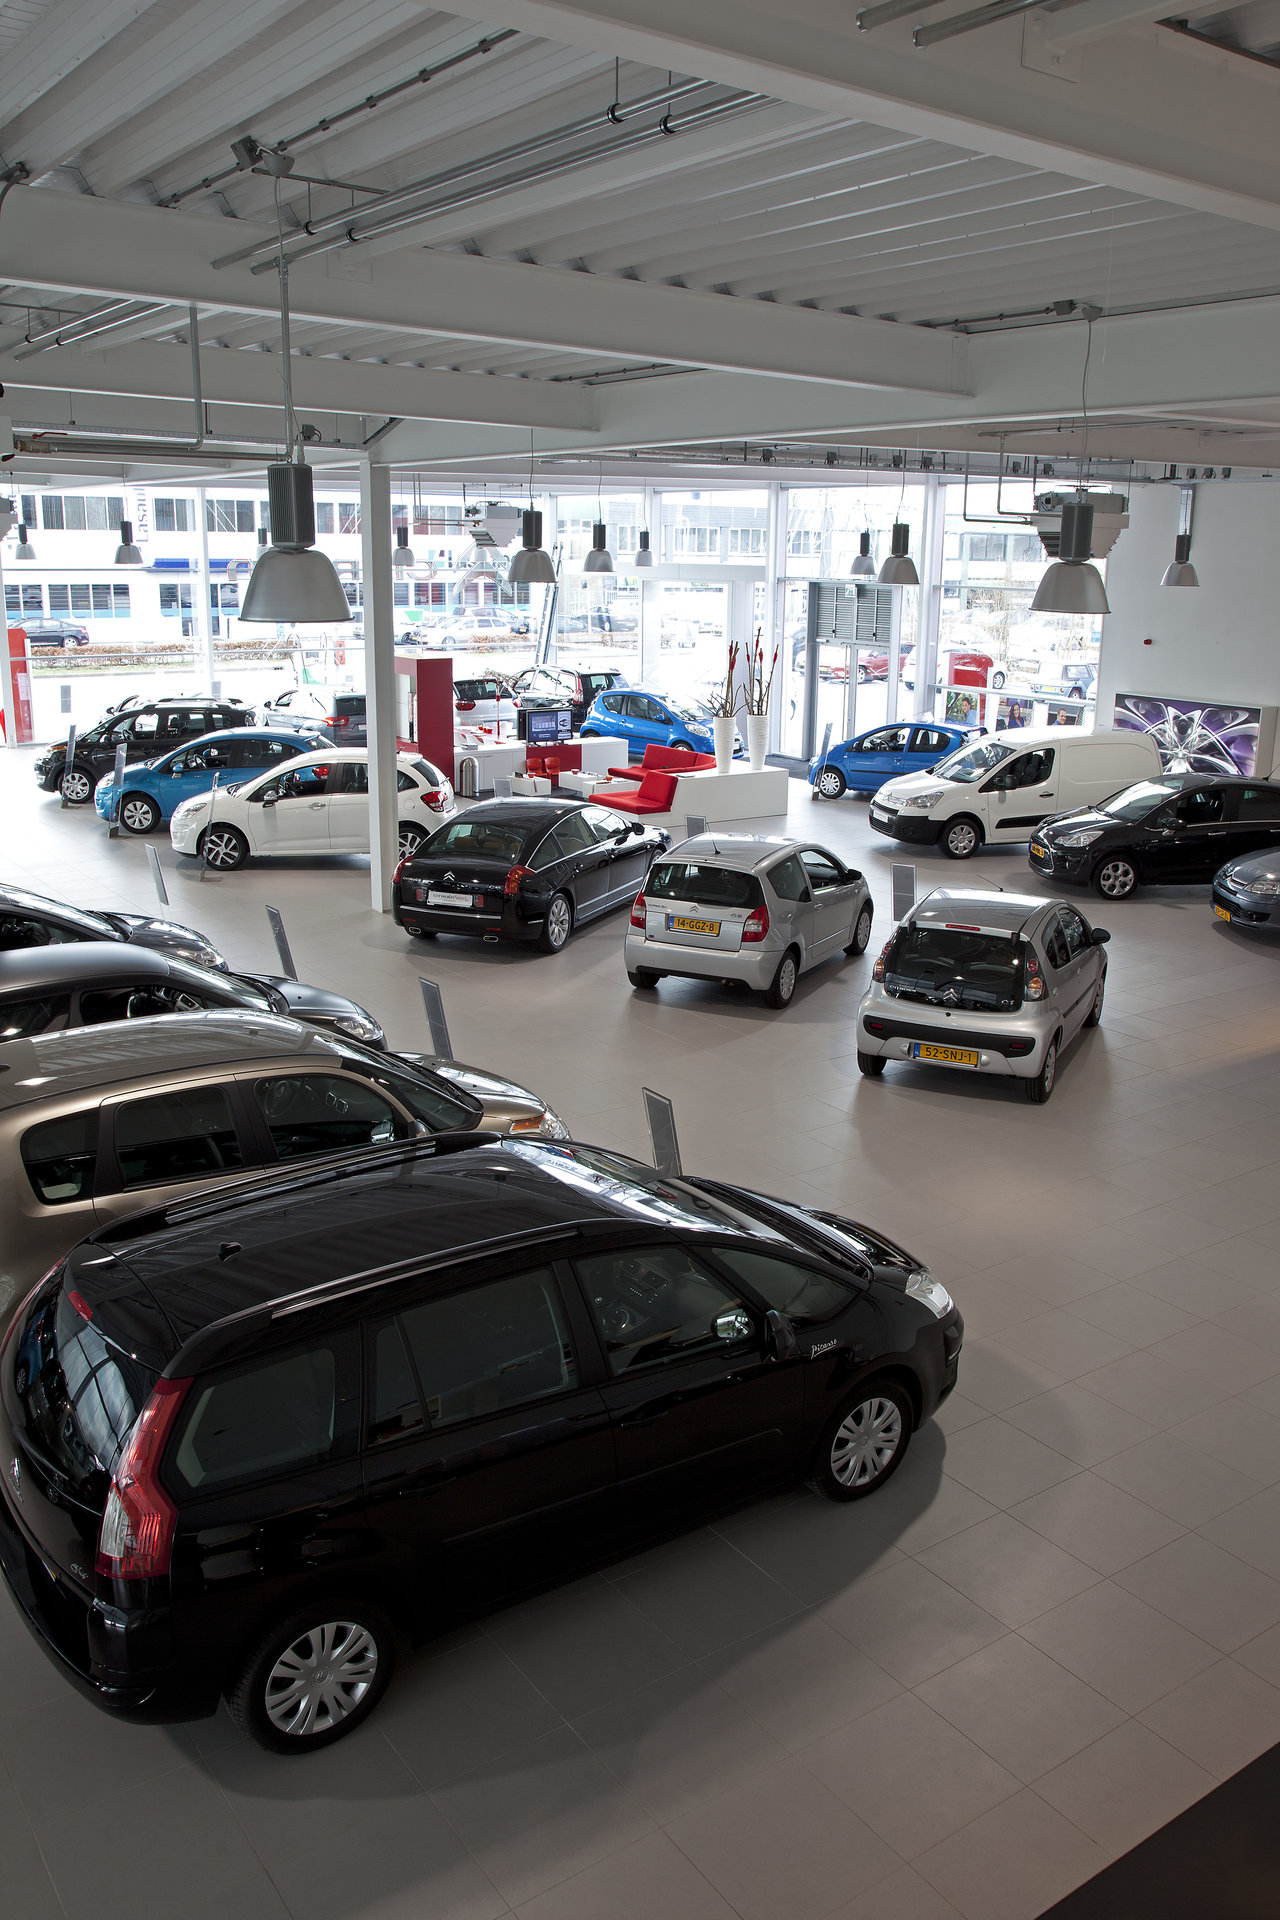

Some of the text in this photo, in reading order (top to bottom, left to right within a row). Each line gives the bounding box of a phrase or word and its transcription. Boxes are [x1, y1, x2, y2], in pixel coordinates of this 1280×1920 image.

[677, 918, 715, 932] 14-GGZ-8
[925, 1047, 972, 1062] 52-SNJ-1
[811, 1338, 838, 1360] Picasso
